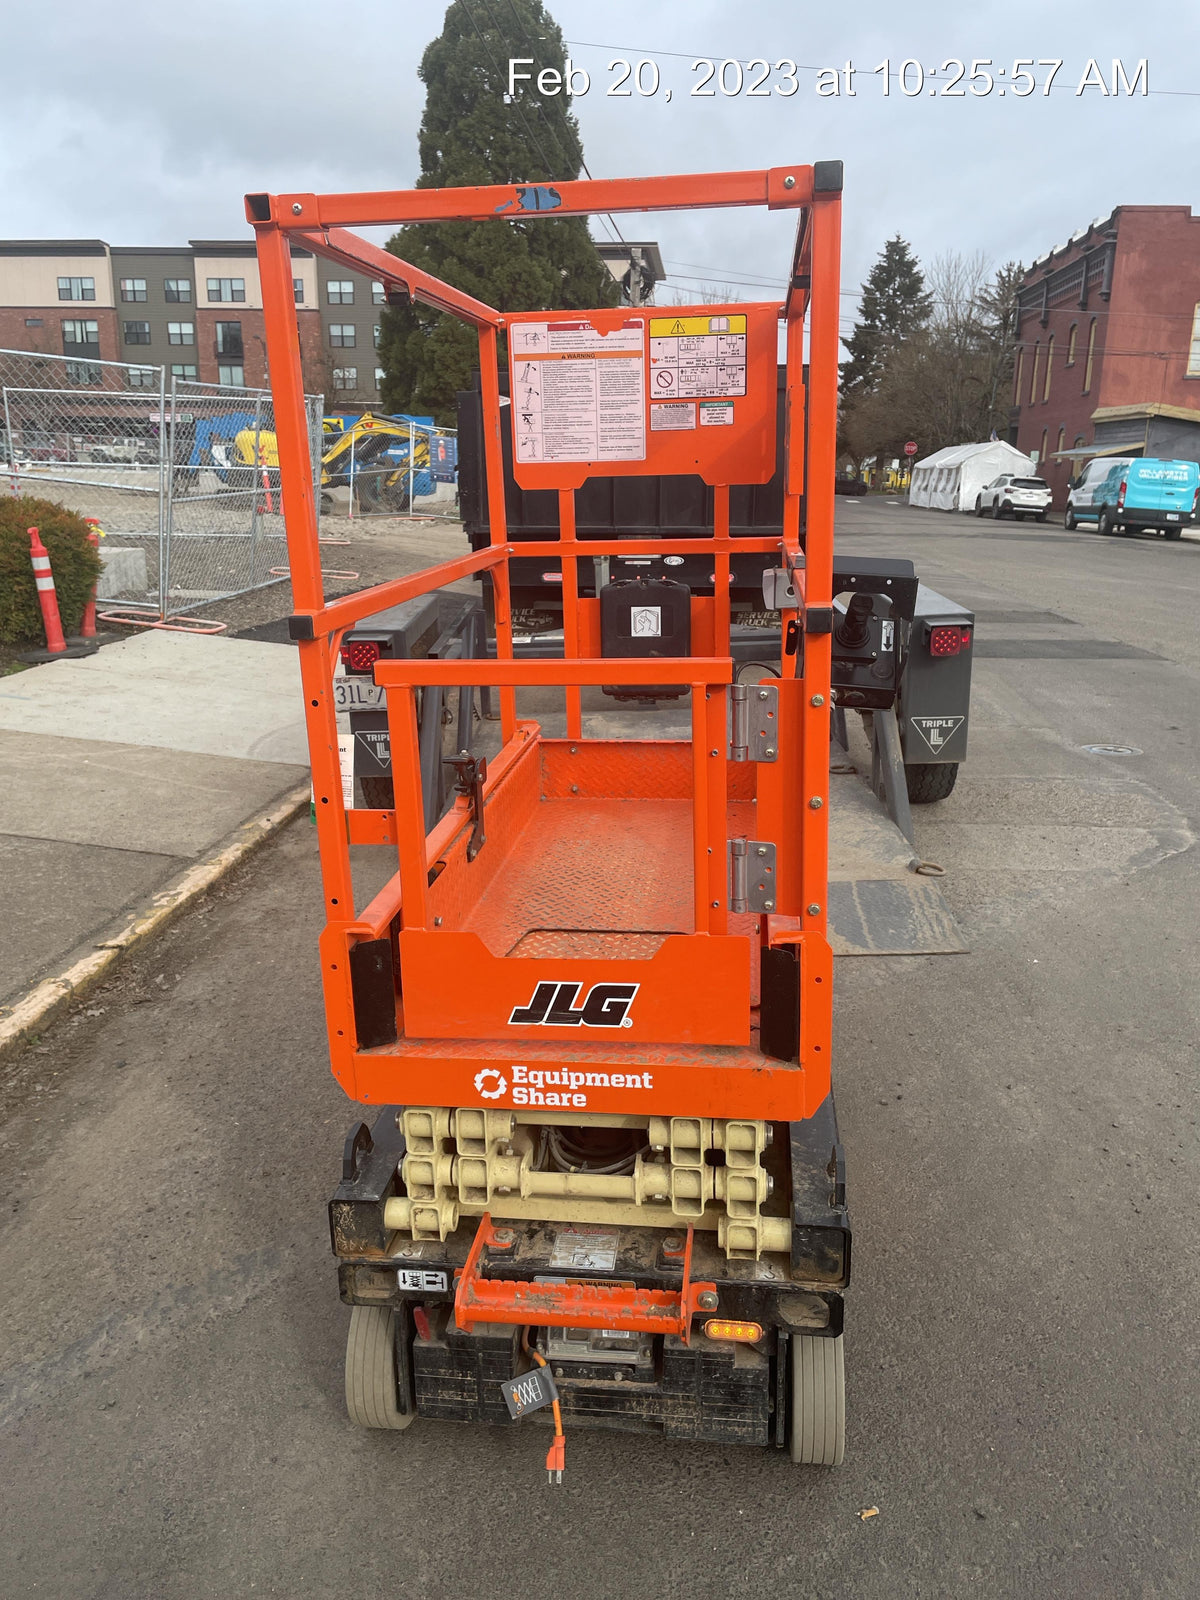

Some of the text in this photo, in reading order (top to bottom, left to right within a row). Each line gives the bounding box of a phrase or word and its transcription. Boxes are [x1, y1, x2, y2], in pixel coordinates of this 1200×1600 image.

[737, 611, 779, 619] SERVICE
[336, 684, 368, 704] 31L
[921, 720, 954, 728] TRIPLE
[507, 981, 640, 1028] JLG
[511, 1066, 653, 1089] Equipment
[512, 1087, 587, 1107] Share
